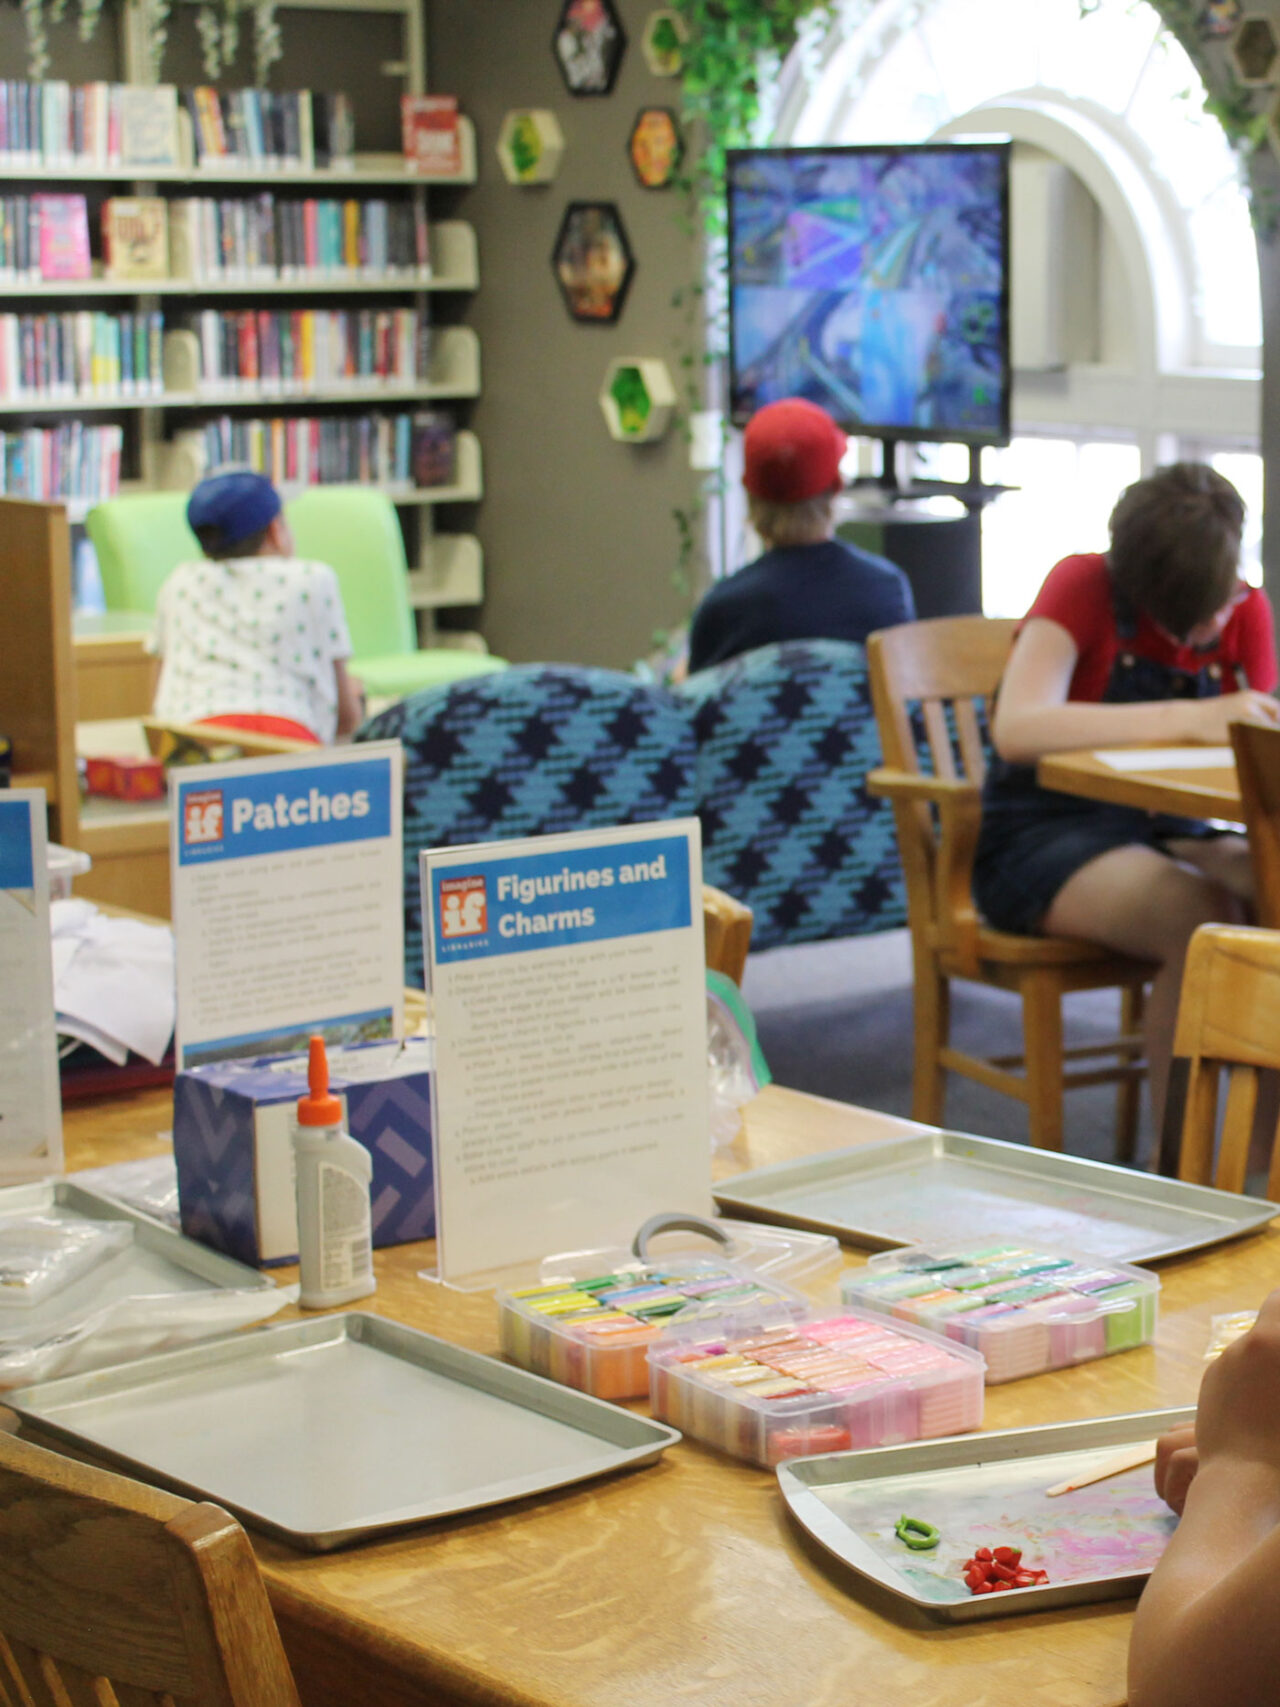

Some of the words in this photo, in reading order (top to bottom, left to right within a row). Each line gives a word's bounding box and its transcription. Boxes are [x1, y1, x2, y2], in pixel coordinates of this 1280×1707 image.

[187, 804, 223, 843] if
[231, 788, 370, 834] Patches
[441, 878, 484, 893] imagine
[497, 867, 614, 905] Figurines
[619, 854, 667, 884] and
[443, 891, 486, 936] if
[498, 906, 596, 938] Charms
